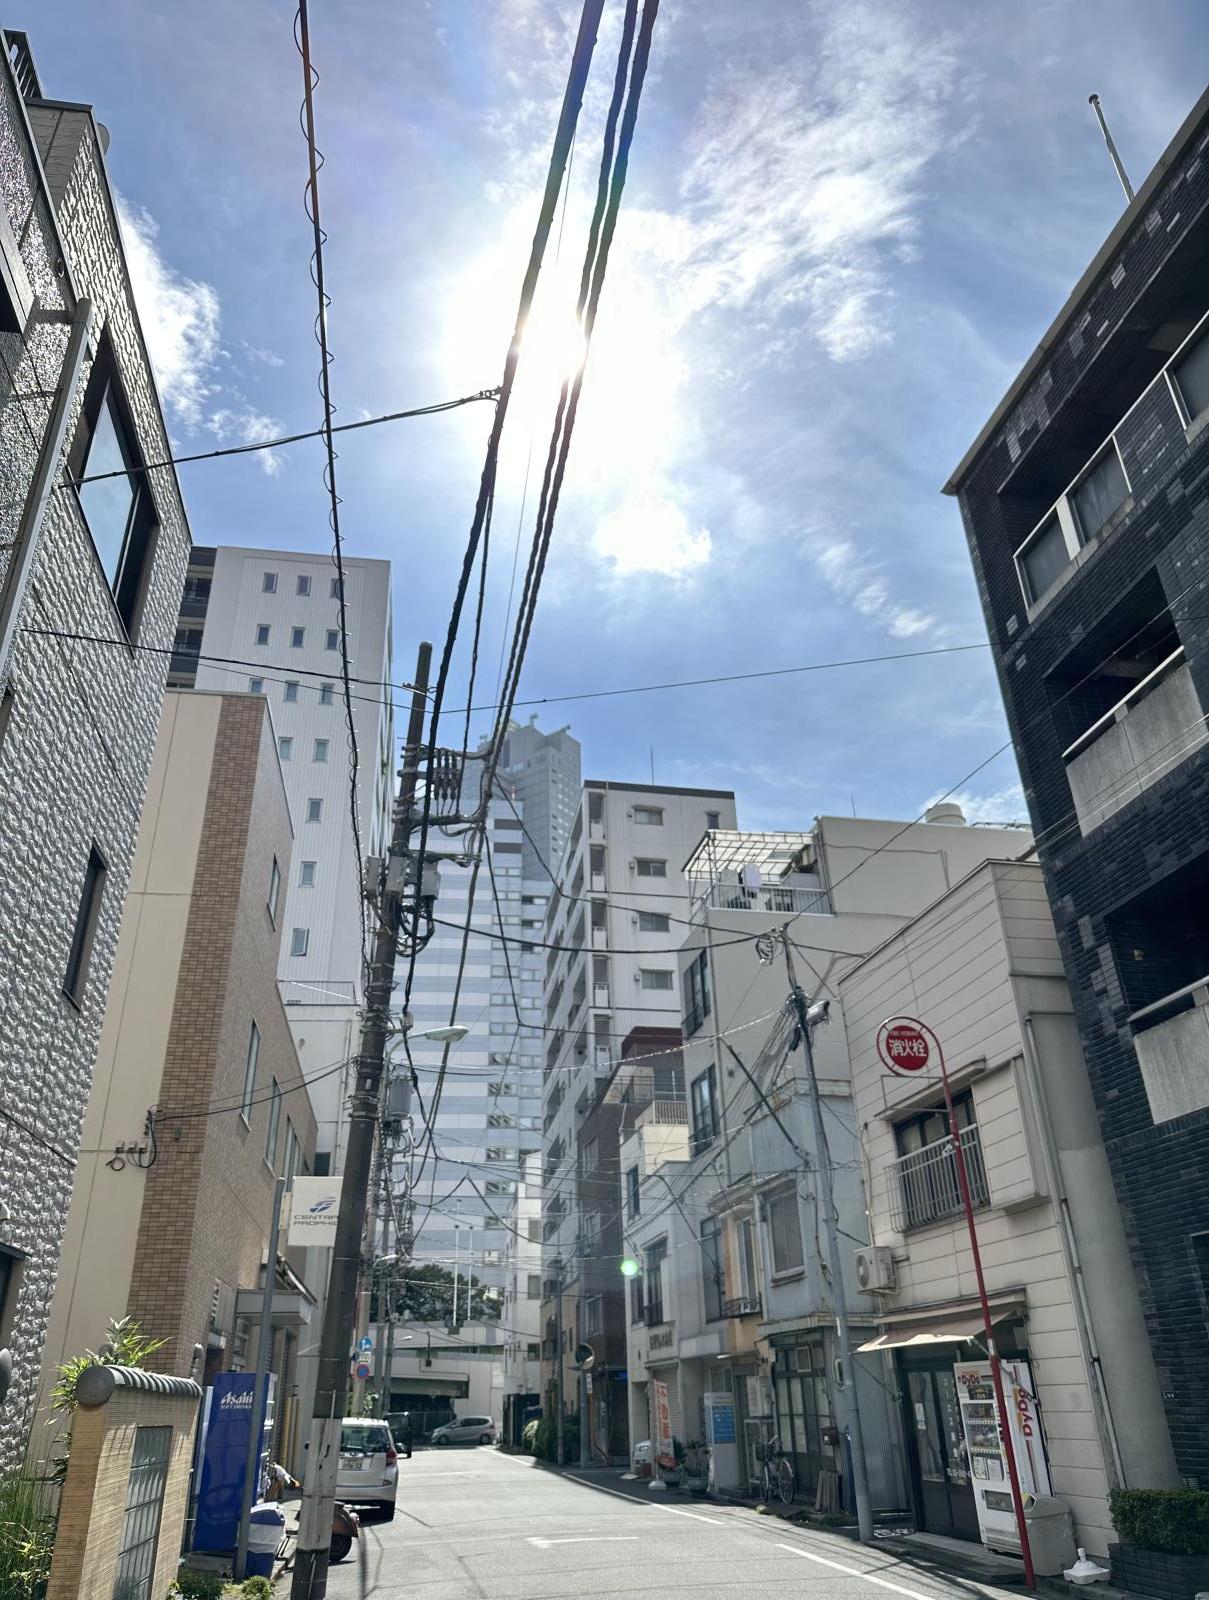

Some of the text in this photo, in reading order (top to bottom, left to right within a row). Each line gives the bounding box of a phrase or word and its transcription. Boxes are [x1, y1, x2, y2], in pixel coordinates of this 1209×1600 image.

[889, 1038, 927, 1056] 消火栓
[220, 1391, 254, 1404] Asahi
